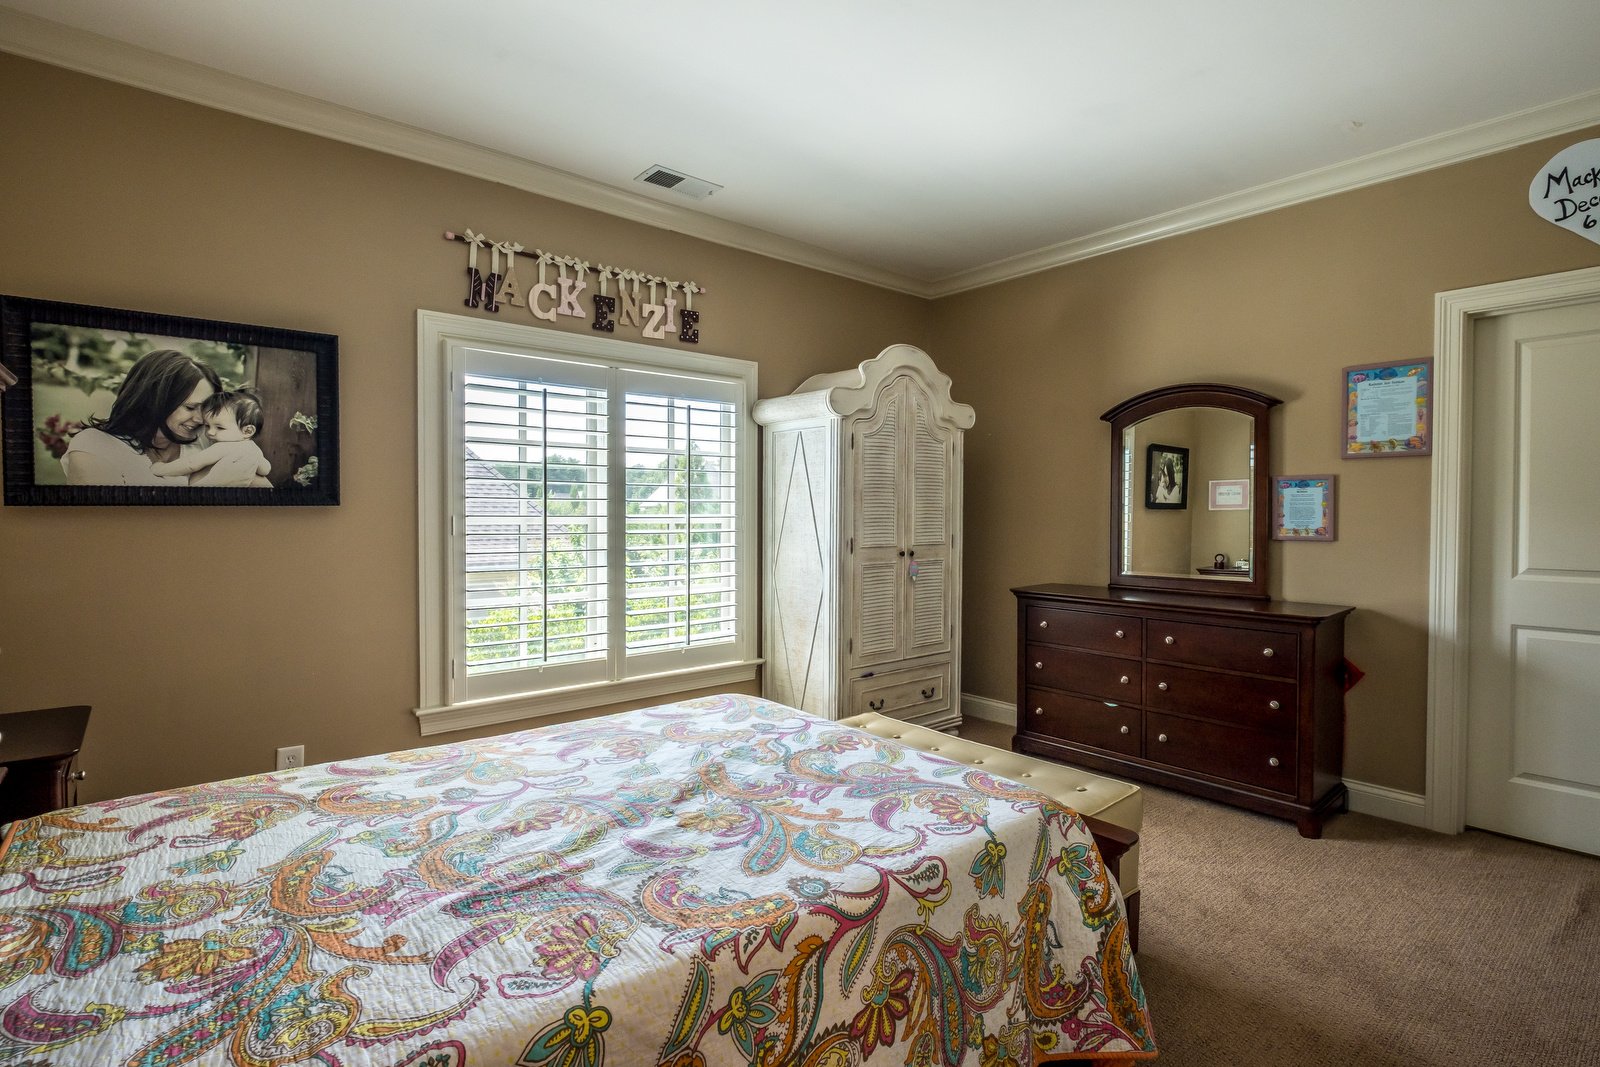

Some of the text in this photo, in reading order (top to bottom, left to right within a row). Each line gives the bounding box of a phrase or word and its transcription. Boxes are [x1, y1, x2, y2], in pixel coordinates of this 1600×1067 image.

[1553, 195, 1600, 222] Dec
[1583, 214, 1597, 229] 6
[465, 266, 700, 344] MACKENZIE
